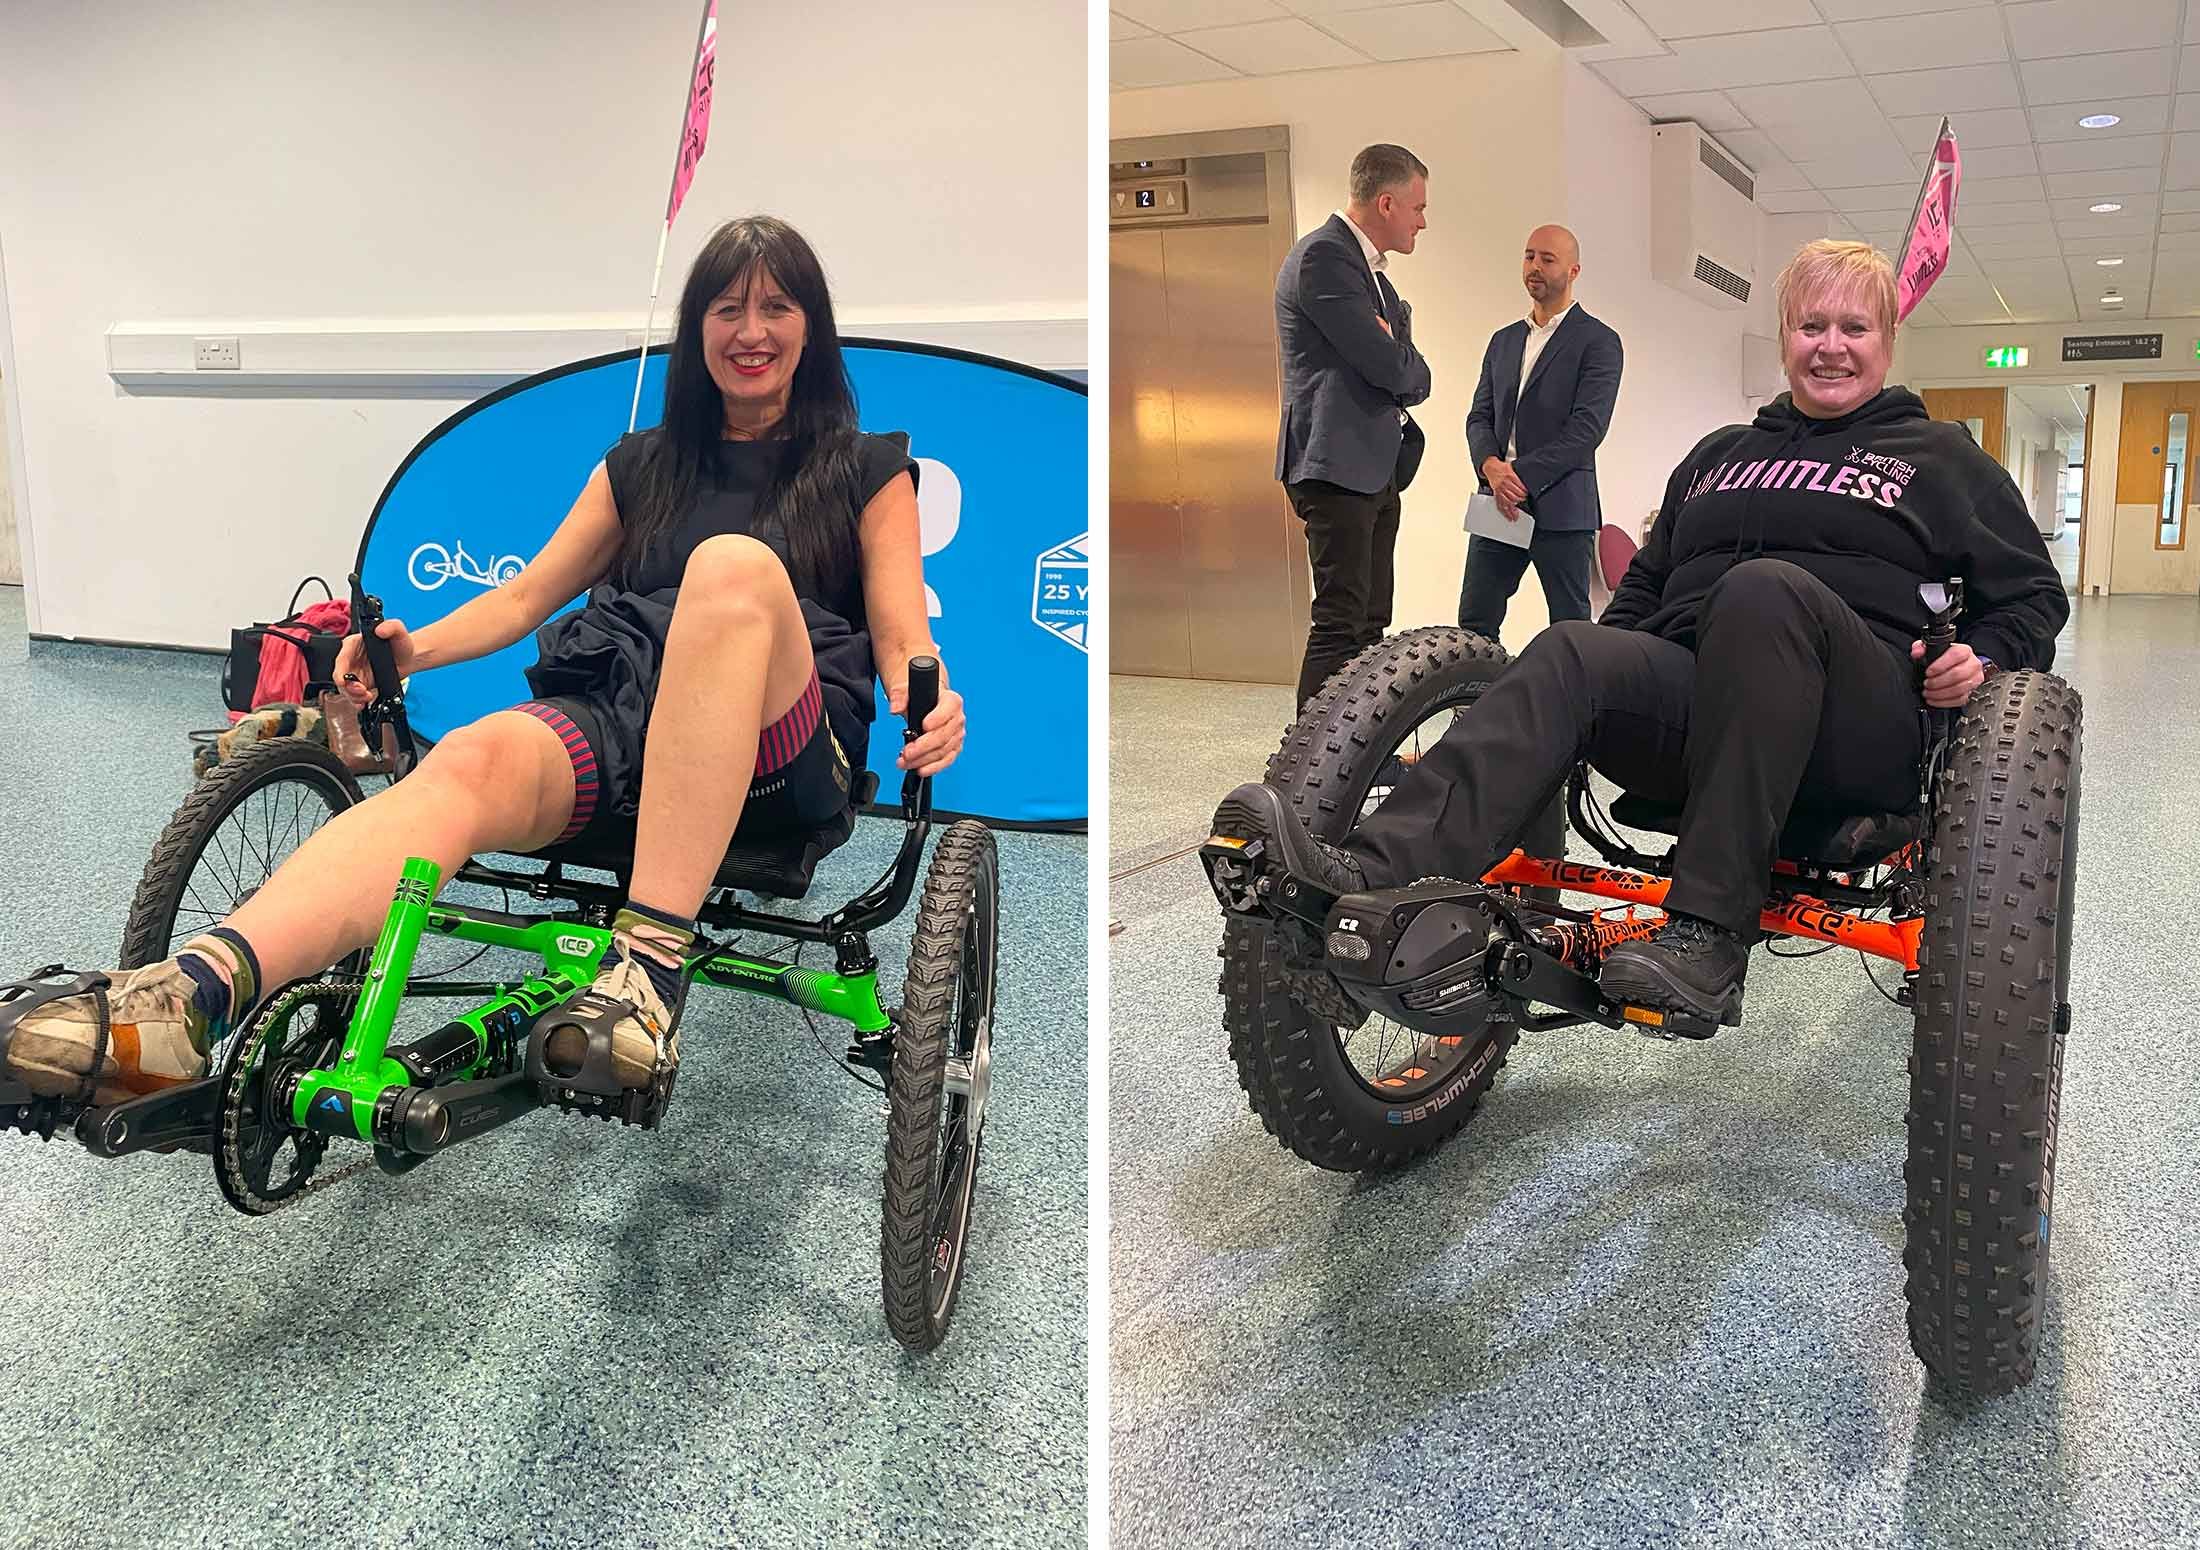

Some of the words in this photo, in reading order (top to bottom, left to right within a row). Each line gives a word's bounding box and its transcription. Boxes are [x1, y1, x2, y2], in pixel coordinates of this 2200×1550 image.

[1142, 191, 1150, 207] 2
[1860, 457, 1912, 486] CYCLING
[1863, 451, 1917, 477] BRITISH
[1716, 458, 1903, 508] LIMITLESS
[1043, 584, 1071, 600] 25
[1439, 979, 1471, 998] SHIMANO
[1402, 1039, 1498, 1124] SCHWALBE
[2039, 1034, 2063, 1217] CHWALBE
